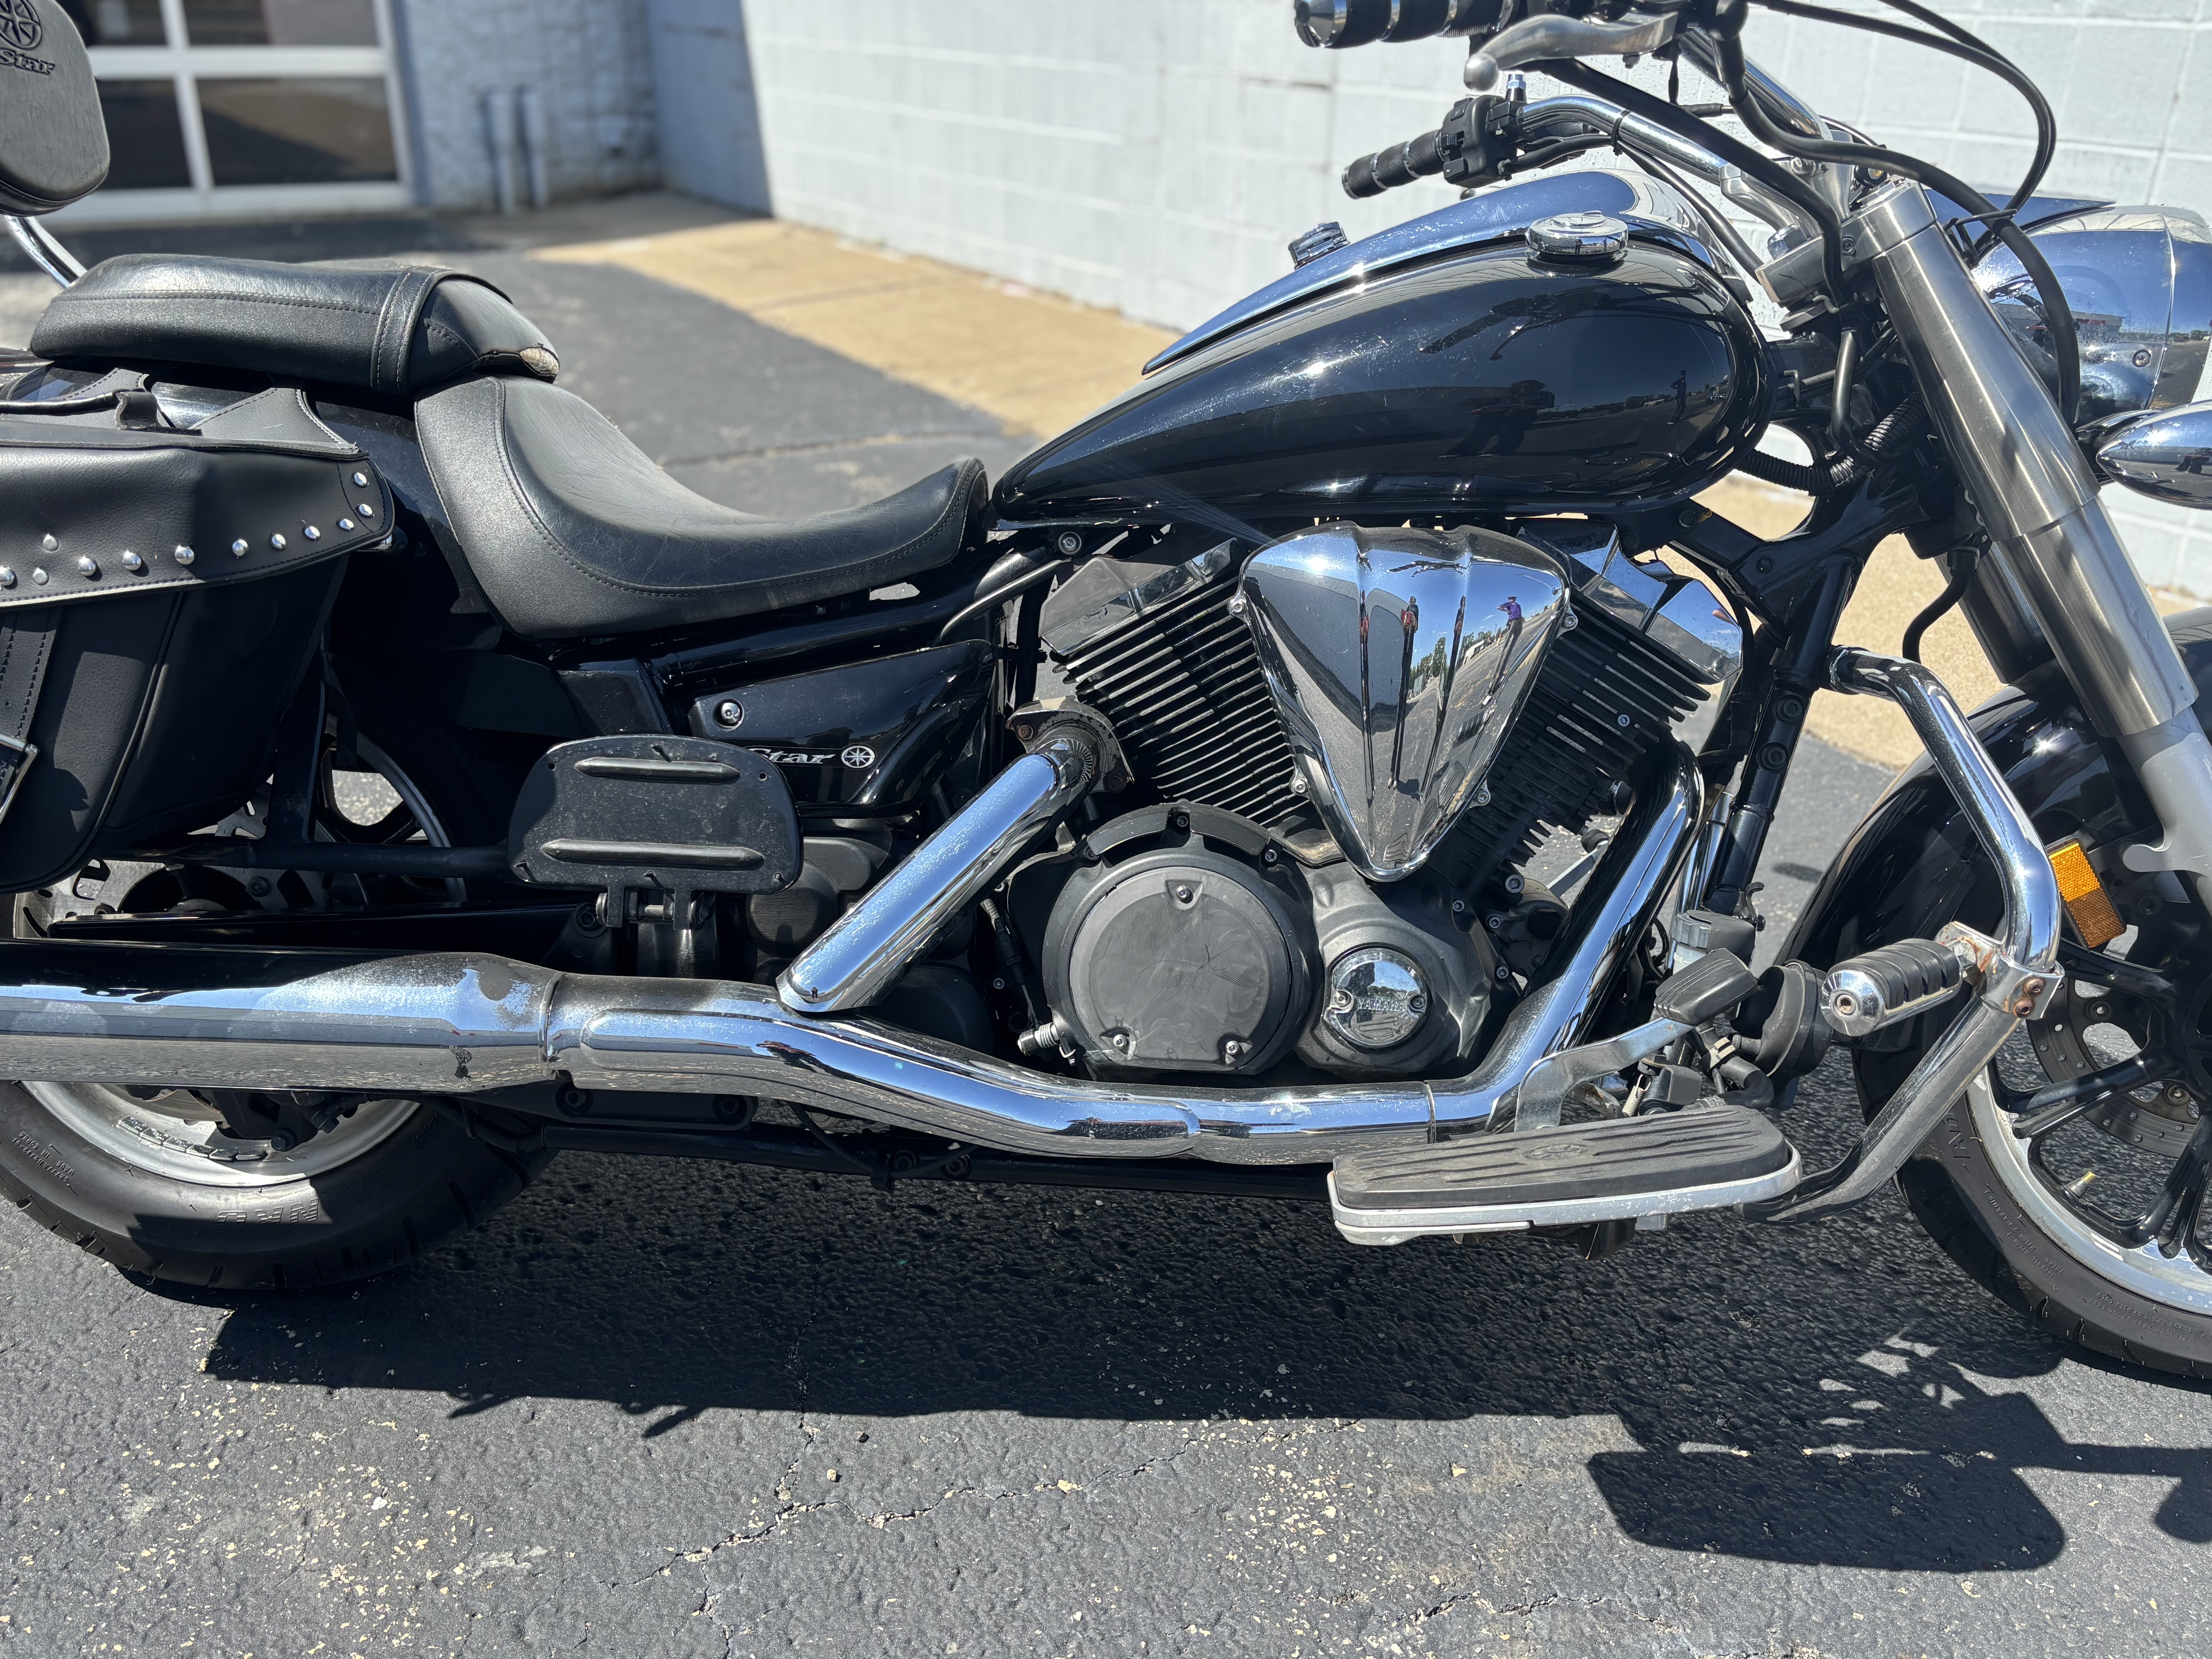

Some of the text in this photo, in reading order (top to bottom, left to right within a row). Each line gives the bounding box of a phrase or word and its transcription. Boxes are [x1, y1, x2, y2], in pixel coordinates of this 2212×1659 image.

[1356, 996, 1406, 1012] YAMAHA
[19, 1131, 76, 1176] MADE IN KOREA
[1989, 1196, 2009, 1221] ARAMID
[2156, 1327, 2174, 1338] LOAD
